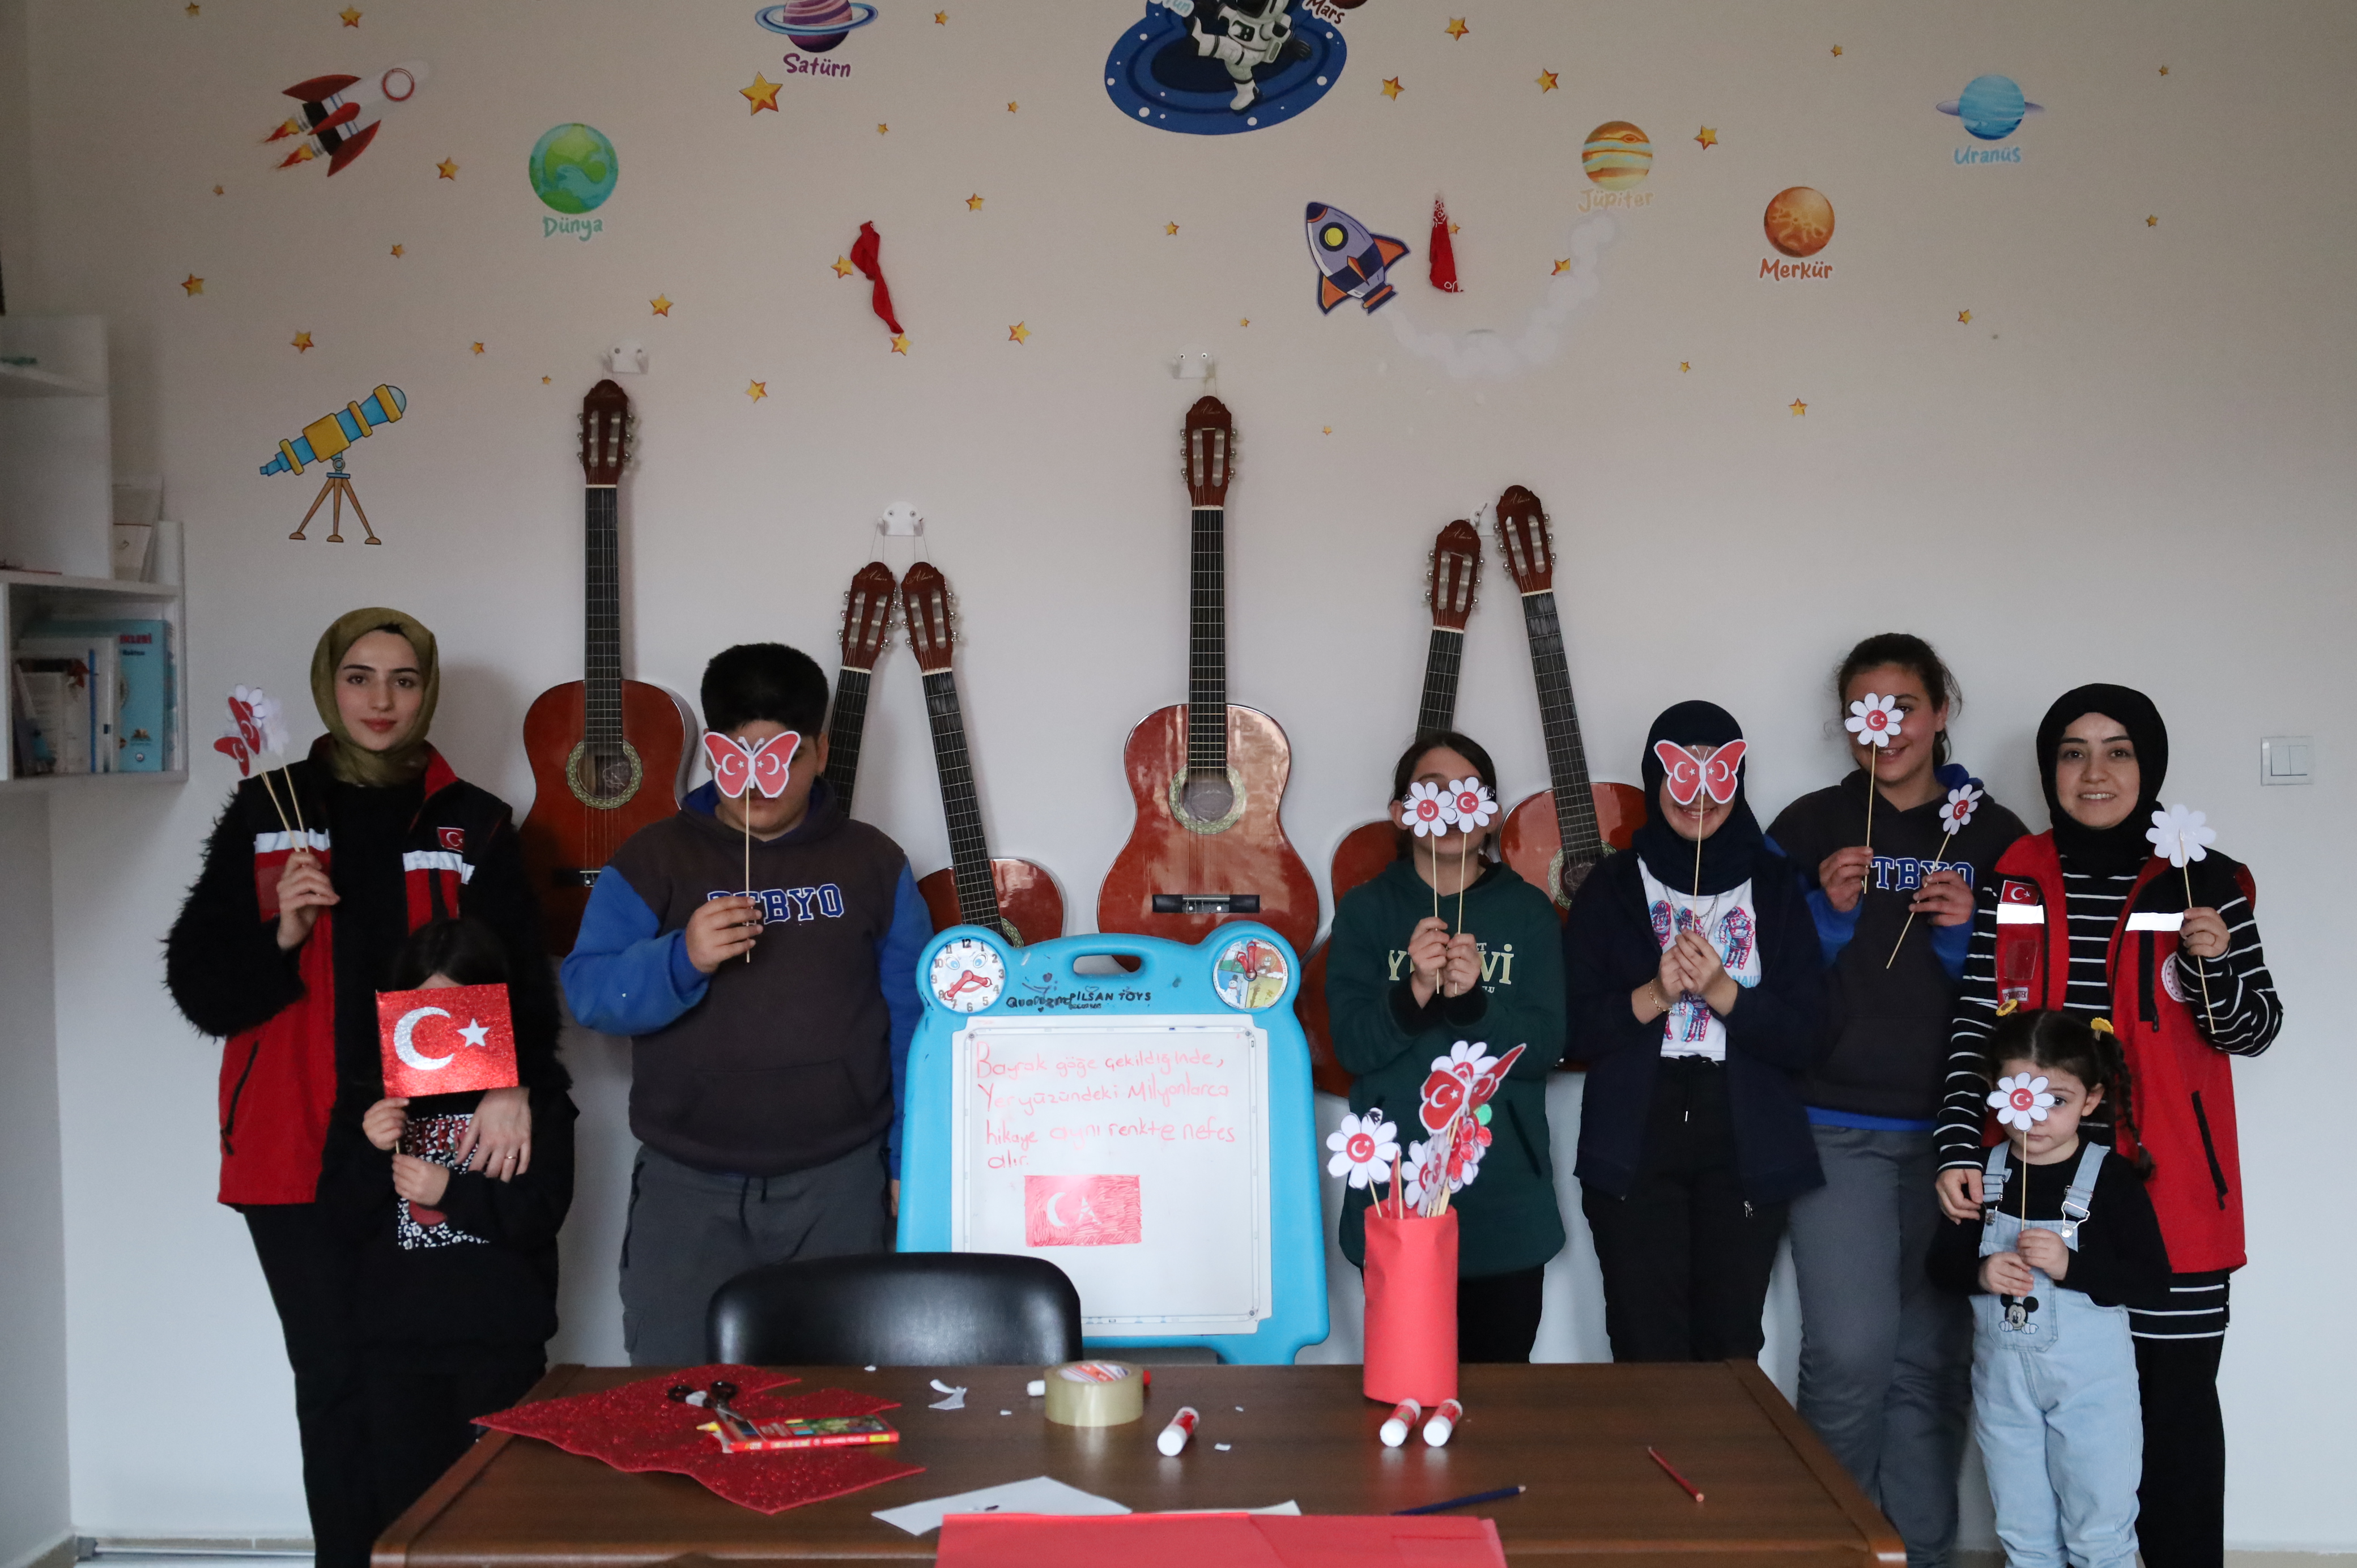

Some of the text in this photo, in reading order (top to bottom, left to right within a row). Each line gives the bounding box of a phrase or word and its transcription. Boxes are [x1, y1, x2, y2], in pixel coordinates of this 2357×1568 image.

[1305, 0, 1345, 24] Mars
[783, 53, 850, 77] Satürn
[1577, 188, 1653, 213] Jüpiter
[542, 216, 603, 241] Dünya
[1759, 258, 1833, 282] Merkür
[962, 939, 971, 948] 12
[981, 941, 984, 952] 1
[945, 944, 952, 954] 11
[934, 958, 943, 968] 10
[992, 954, 998, 963] 2
[998, 969, 1005, 978] 3
[931, 974, 938, 984] 9
[938, 990, 944, 999] 8
[993, 985, 999, 994] 4
[982, 996, 989, 1005] 5
[1119, 991, 1151, 1001] TOYS
[951, 999, 958, 1009] 7
[967, 1002, 973, 1012] 6
[977, 1041, 1047, 1080] Bayrak
[1128, 1071, 1229, 1107] Milyonlarca
[986, 1119, 1038, 1151] hikaye
[1108, 1117, 1176, 1140] renkte
[1183, 1115, 1235, 1143] nefes
